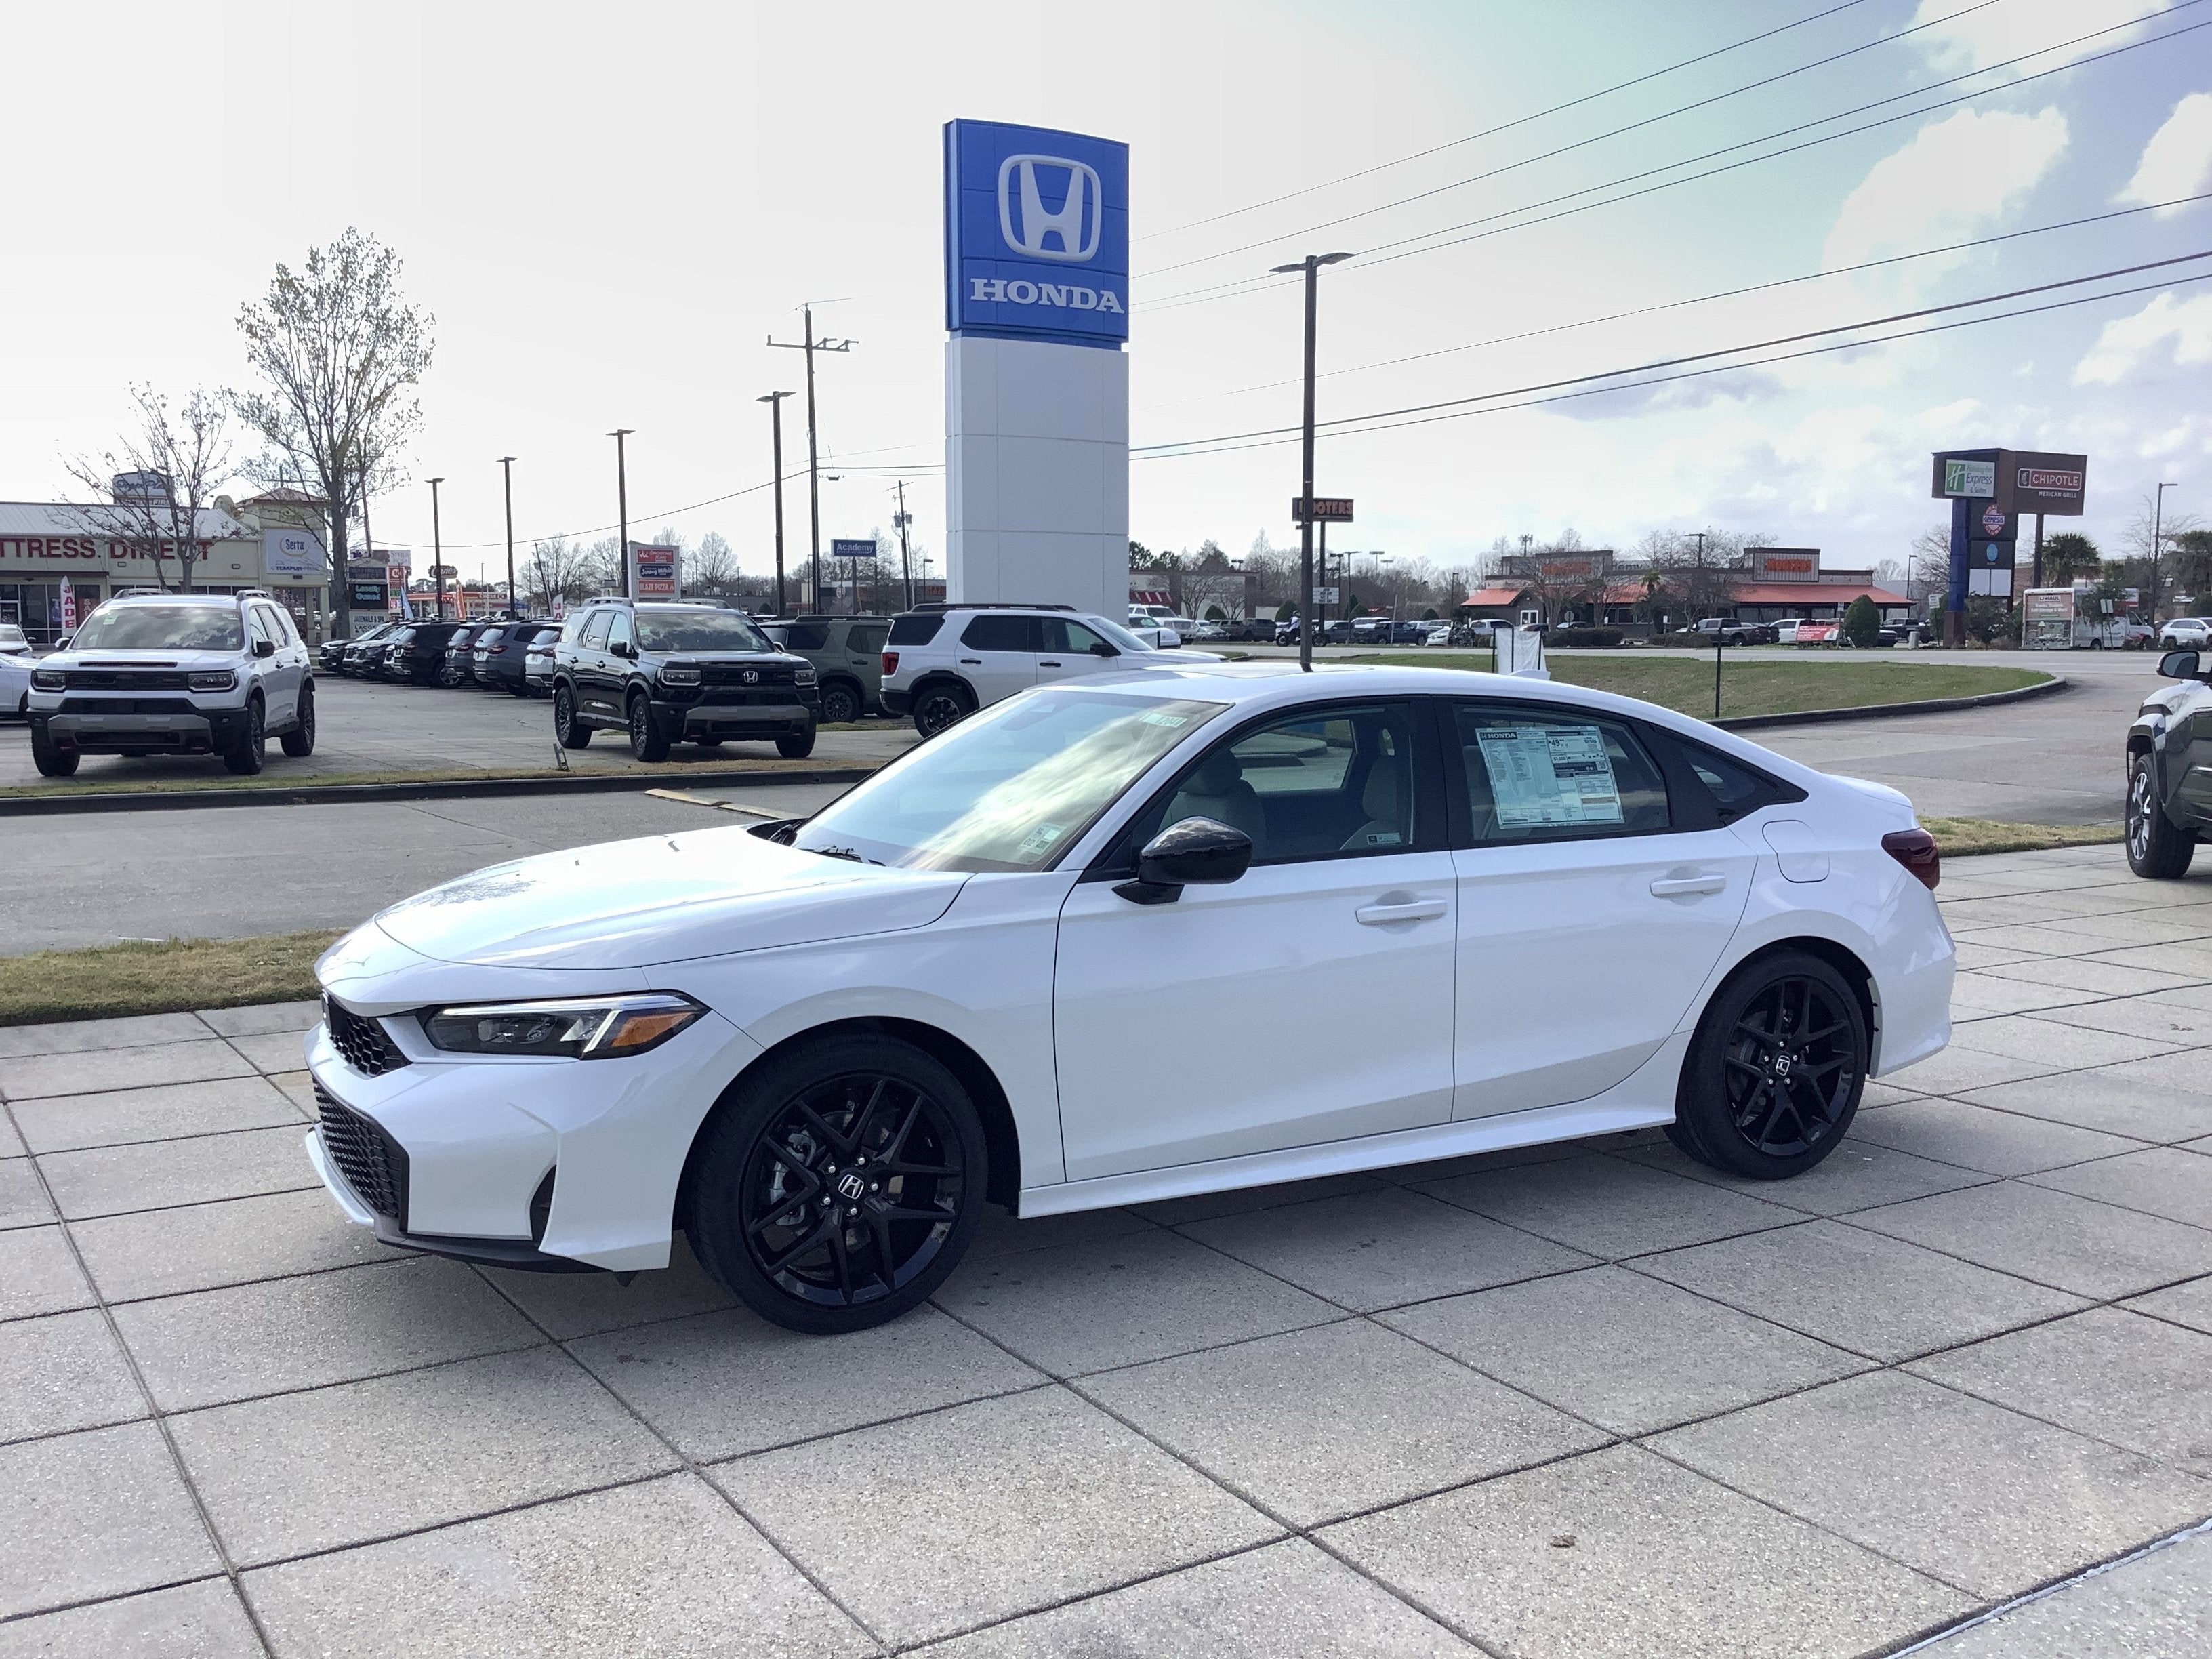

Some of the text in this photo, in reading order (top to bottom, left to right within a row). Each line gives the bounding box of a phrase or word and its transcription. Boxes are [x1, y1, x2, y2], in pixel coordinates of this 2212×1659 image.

[970, 278, 1125, 314] HONDA
[1966, 472, 1992, 486] Express
[2032, 474, 2078, 486] CHIPOTLE
[1298, 501, 1353, 515] OTERS
[110, 539, 213, 560] DIET
[285, 539, 304, 550] Serta
[836, 543, 874, 553] Academy
[655, 583, 669, 592] PIZZA
